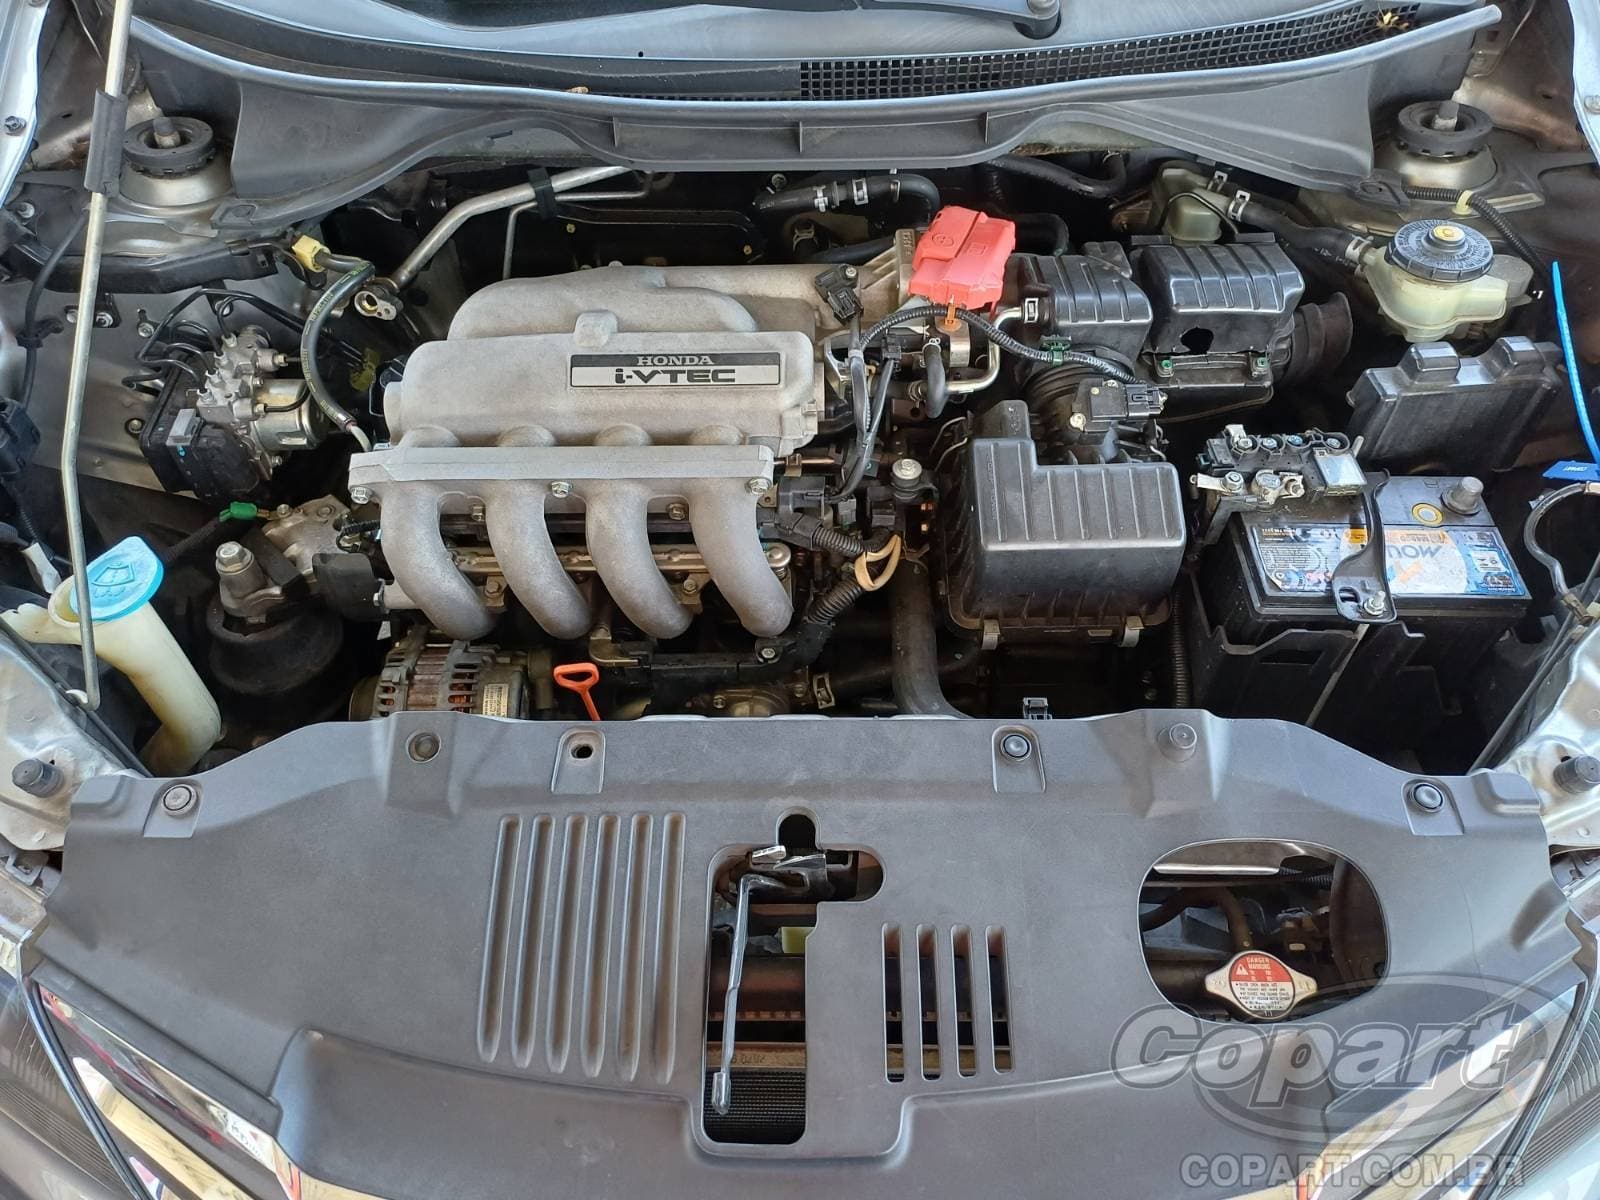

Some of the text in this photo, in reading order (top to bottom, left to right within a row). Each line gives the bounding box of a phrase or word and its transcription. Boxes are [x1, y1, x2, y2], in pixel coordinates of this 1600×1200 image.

[636, 355, 714, 366] HONDA
[614, 368, 736, 384] i-VTEC
[1386, 544, 1442, 559] MOU
